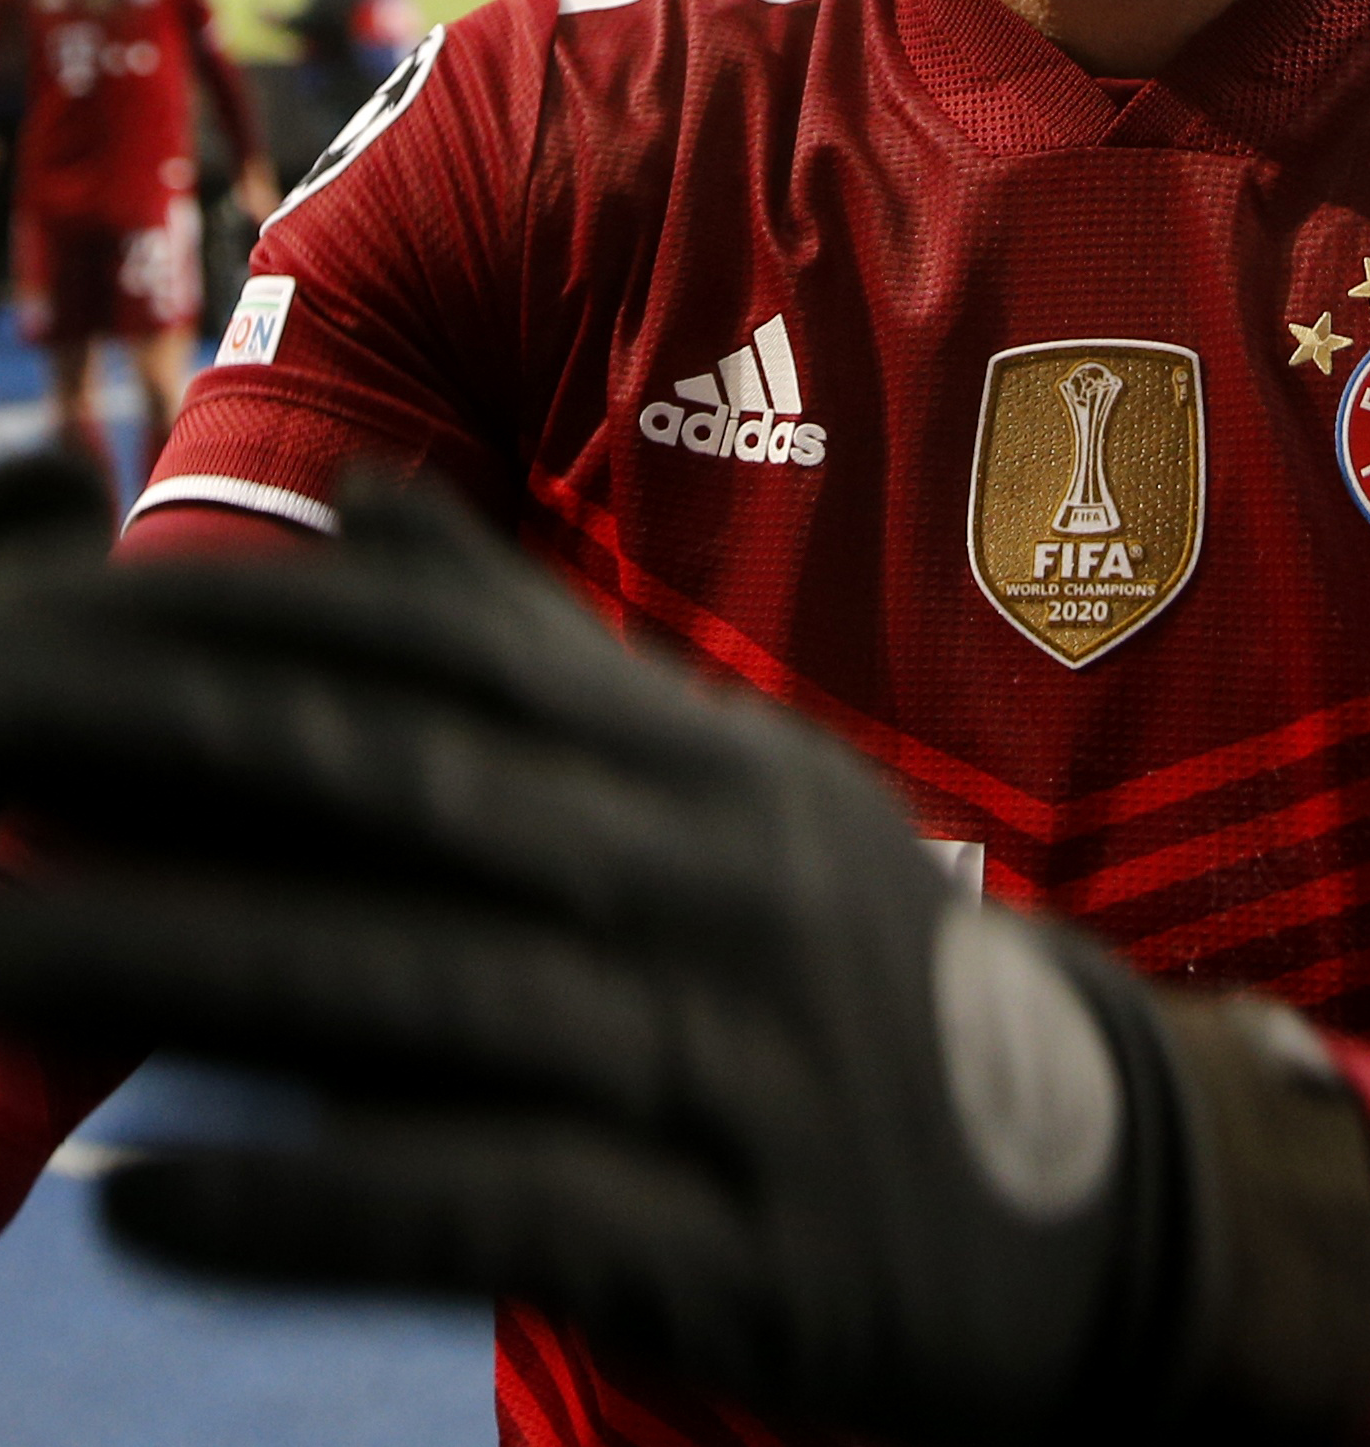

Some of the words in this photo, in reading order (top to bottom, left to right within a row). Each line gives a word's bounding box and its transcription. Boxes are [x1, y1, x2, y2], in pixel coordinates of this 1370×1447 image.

[639, 402, 827, 466] adidas
[1006, 583, 1060, 597] WORLD
[1064, 583, 1157, 597] CHAMPIONS
[1048, 601, 1109, 622] 2020
